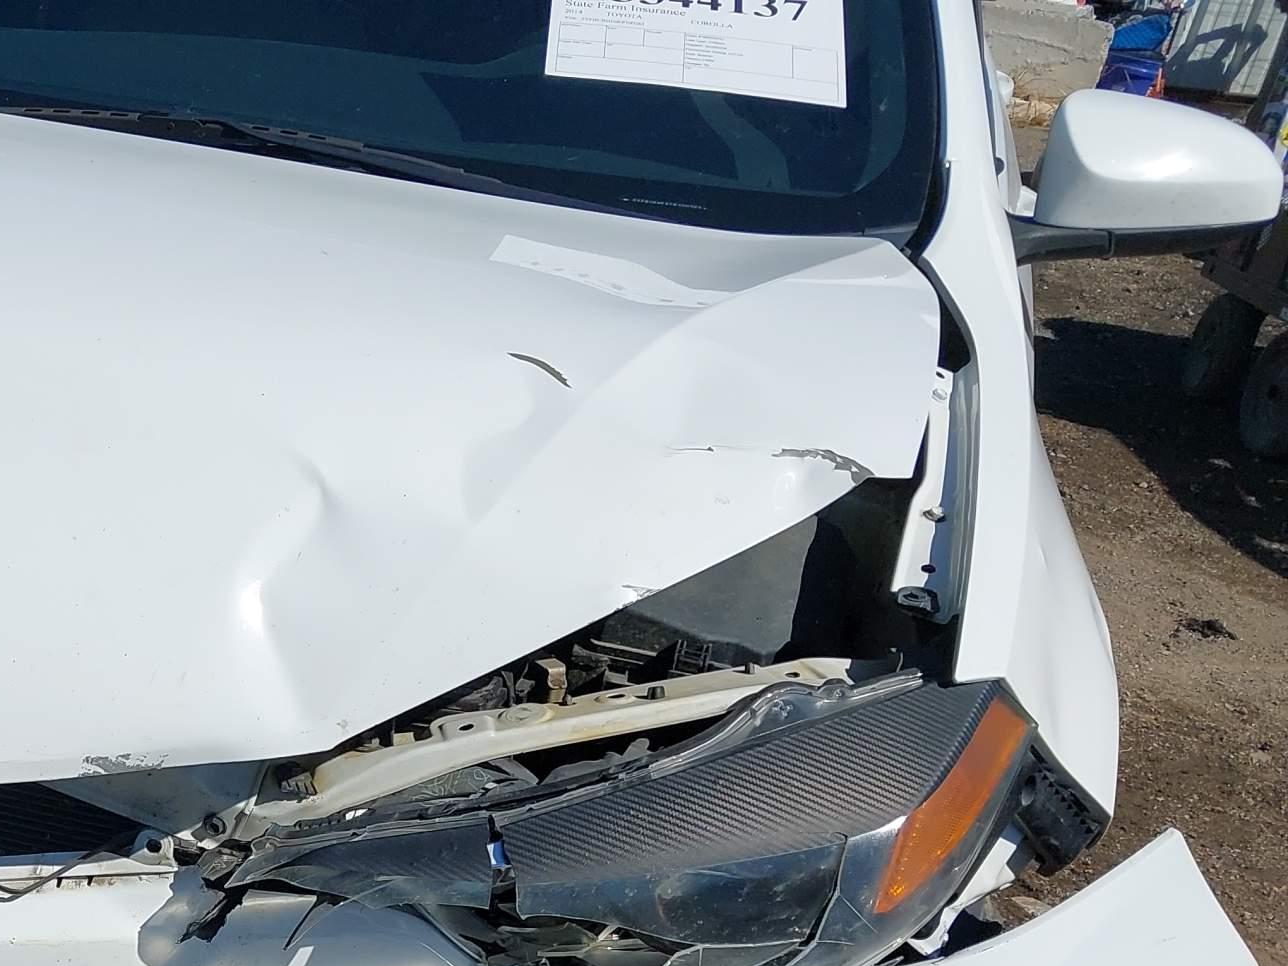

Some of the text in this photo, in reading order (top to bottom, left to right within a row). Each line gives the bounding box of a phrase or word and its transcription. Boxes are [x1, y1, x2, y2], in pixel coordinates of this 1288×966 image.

[565, 0, 686, 16] State Farm Insurance
